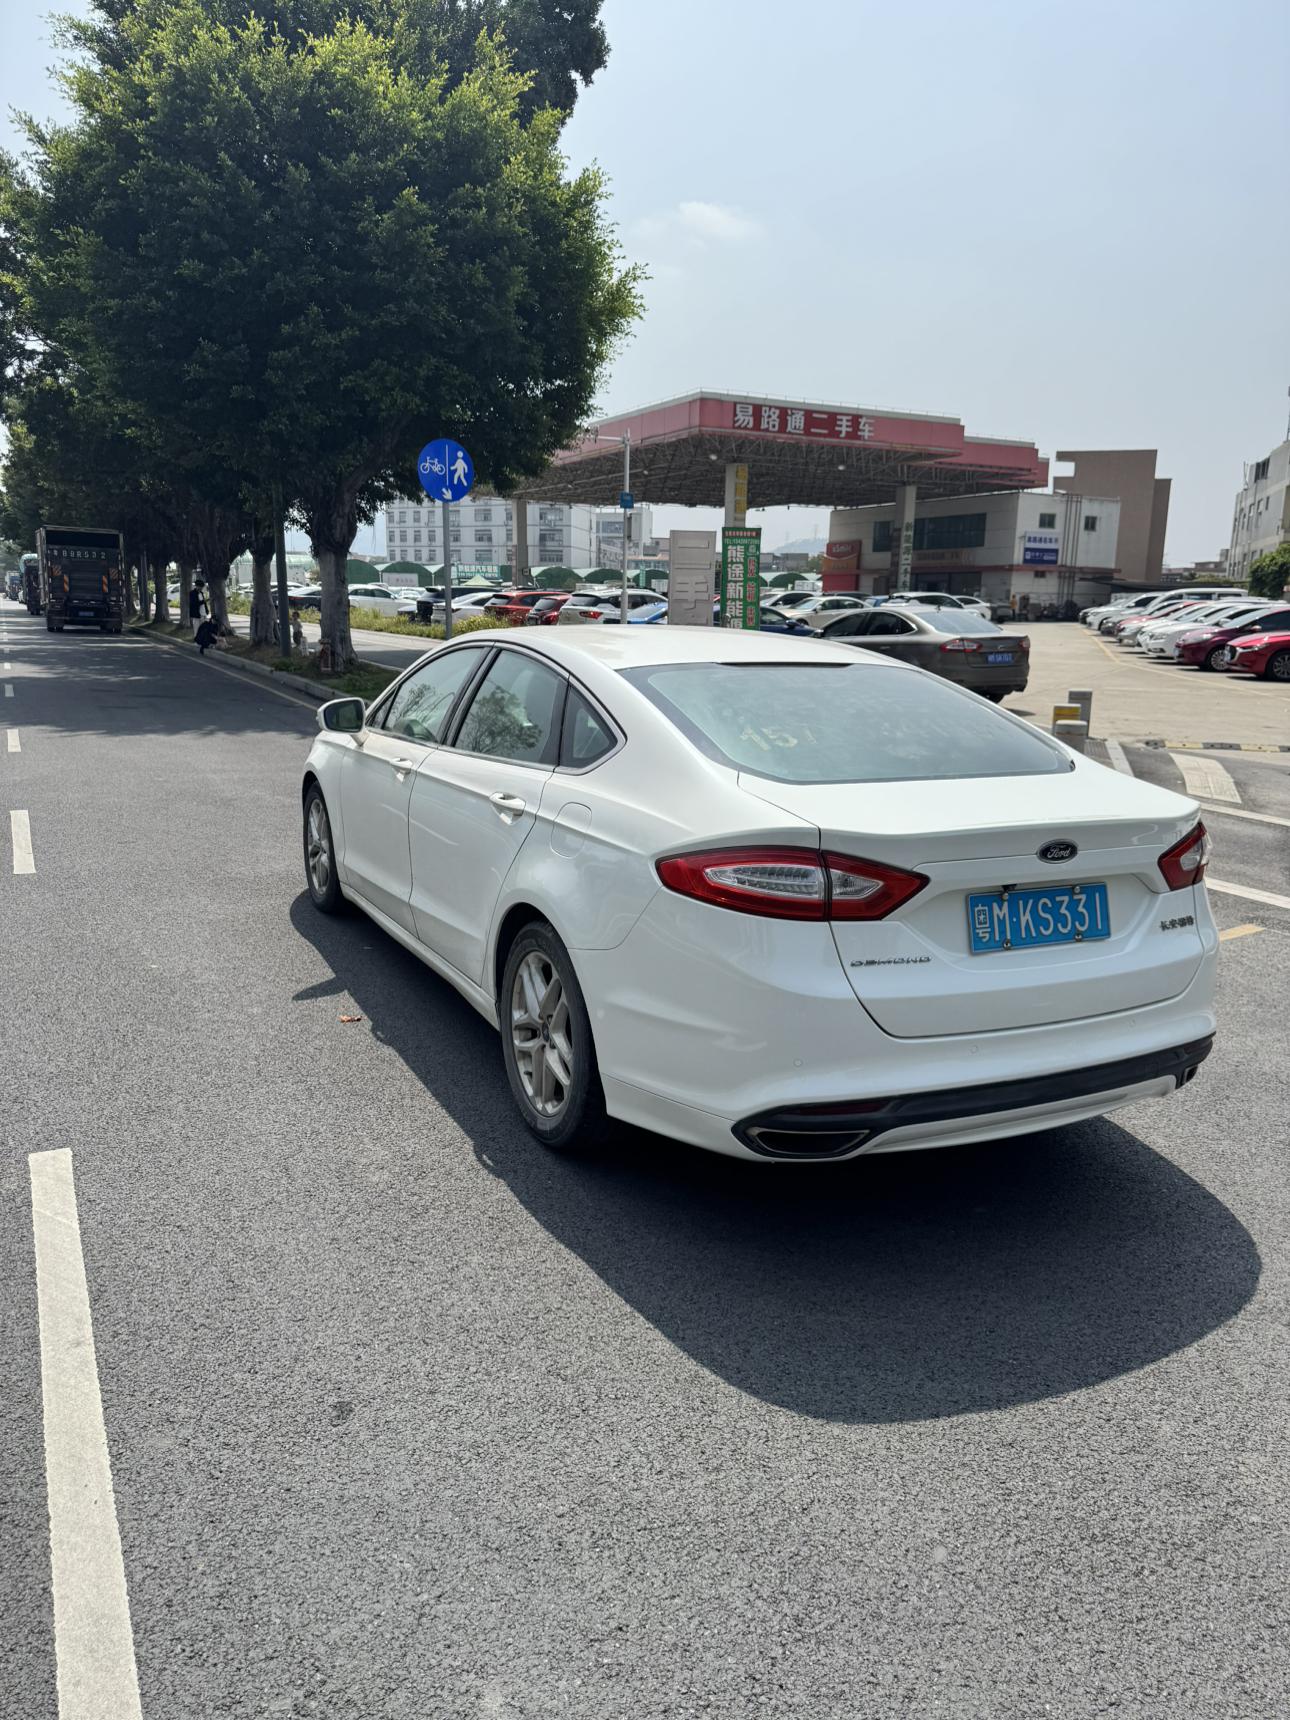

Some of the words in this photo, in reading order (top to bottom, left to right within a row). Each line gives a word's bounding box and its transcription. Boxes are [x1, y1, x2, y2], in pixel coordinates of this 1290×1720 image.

[734, 403, 875, 439] 易路通二手车
[1046, 847, 1072, 859] Ford
